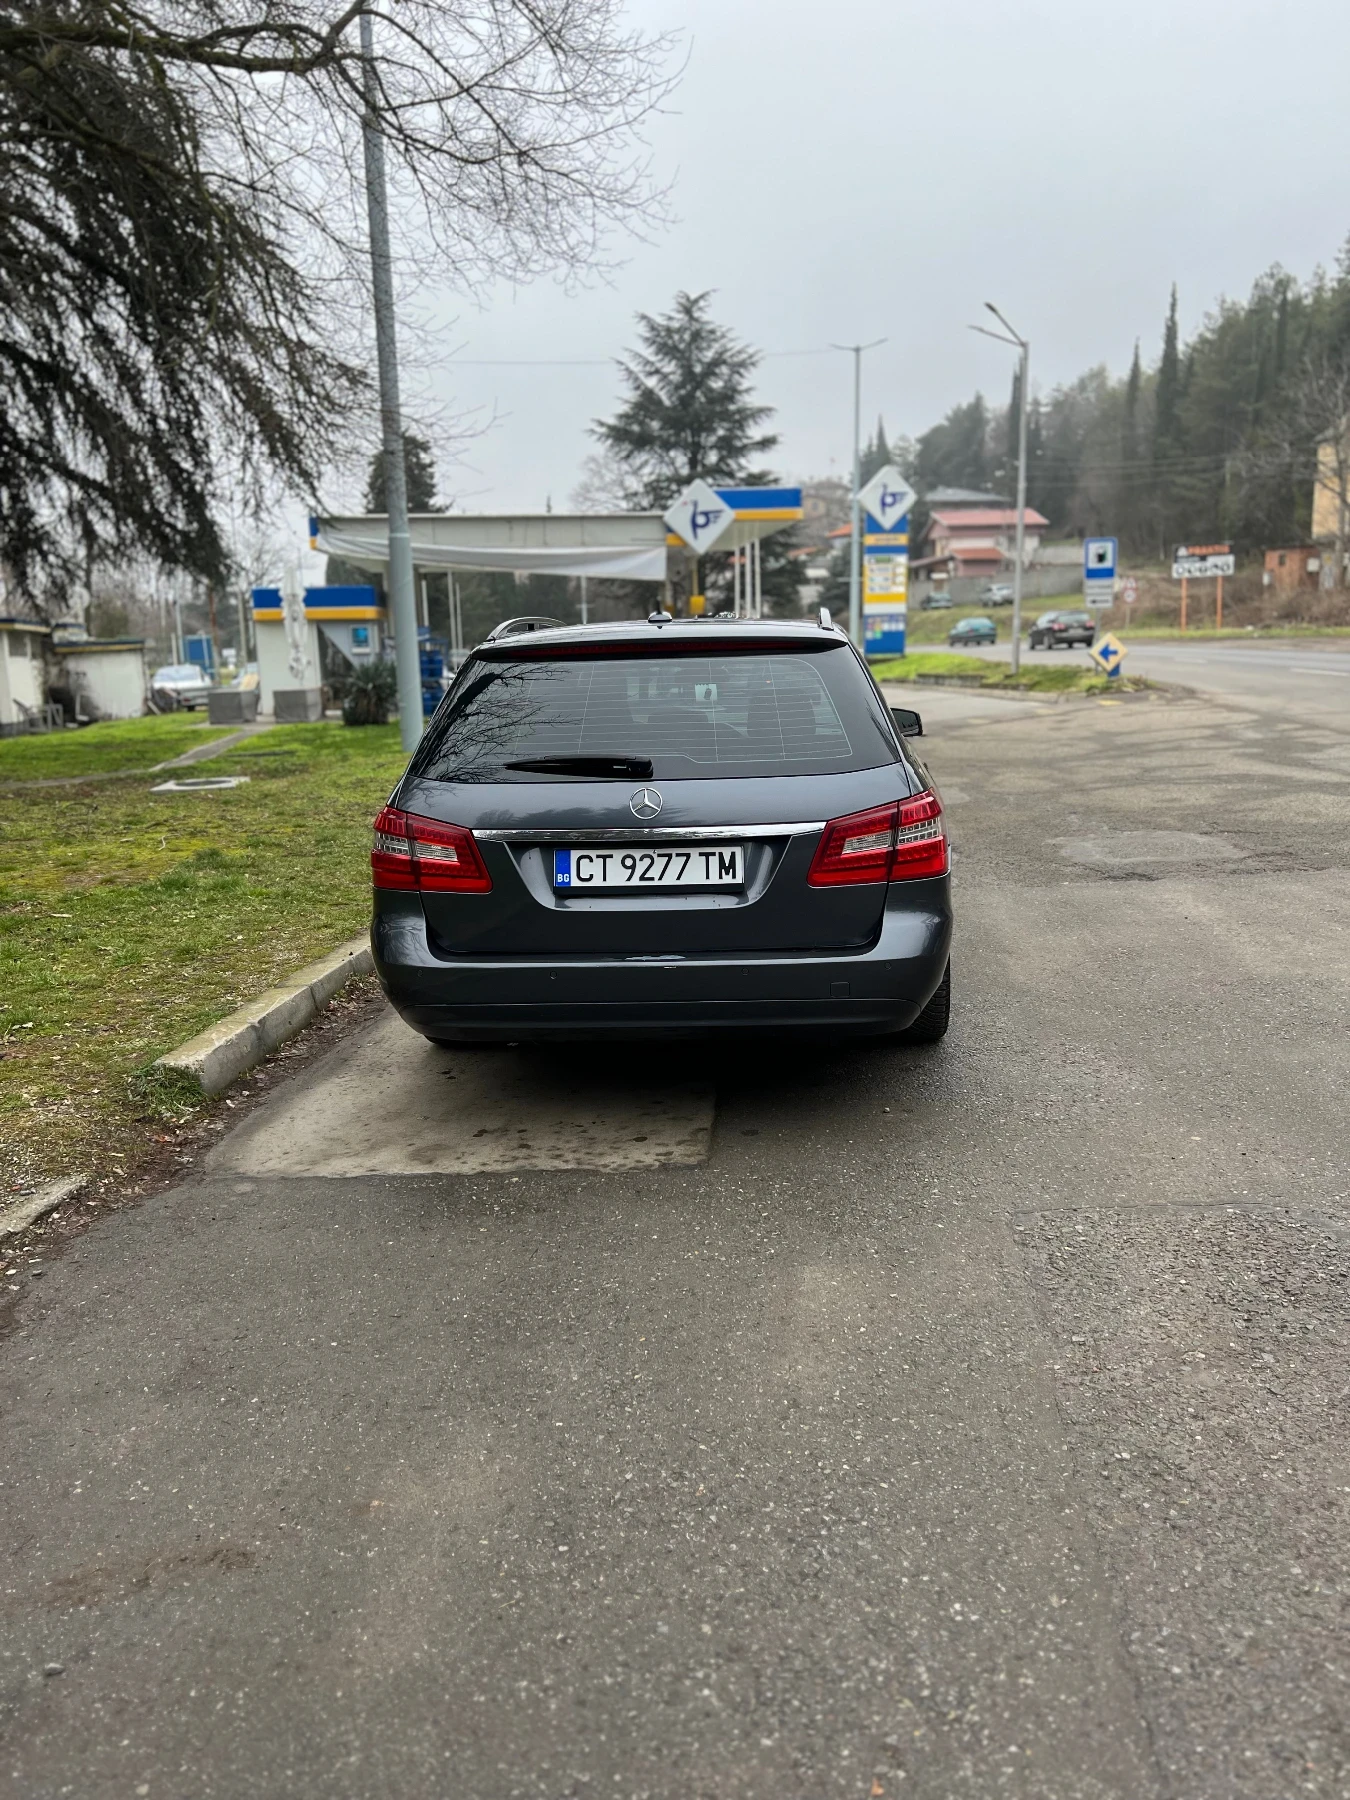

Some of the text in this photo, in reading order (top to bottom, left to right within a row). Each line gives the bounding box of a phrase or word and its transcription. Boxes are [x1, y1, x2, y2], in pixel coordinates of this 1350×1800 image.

[576, 851, 736, 882] CT 9277 TM
[557, 873, 569, 882] BG
